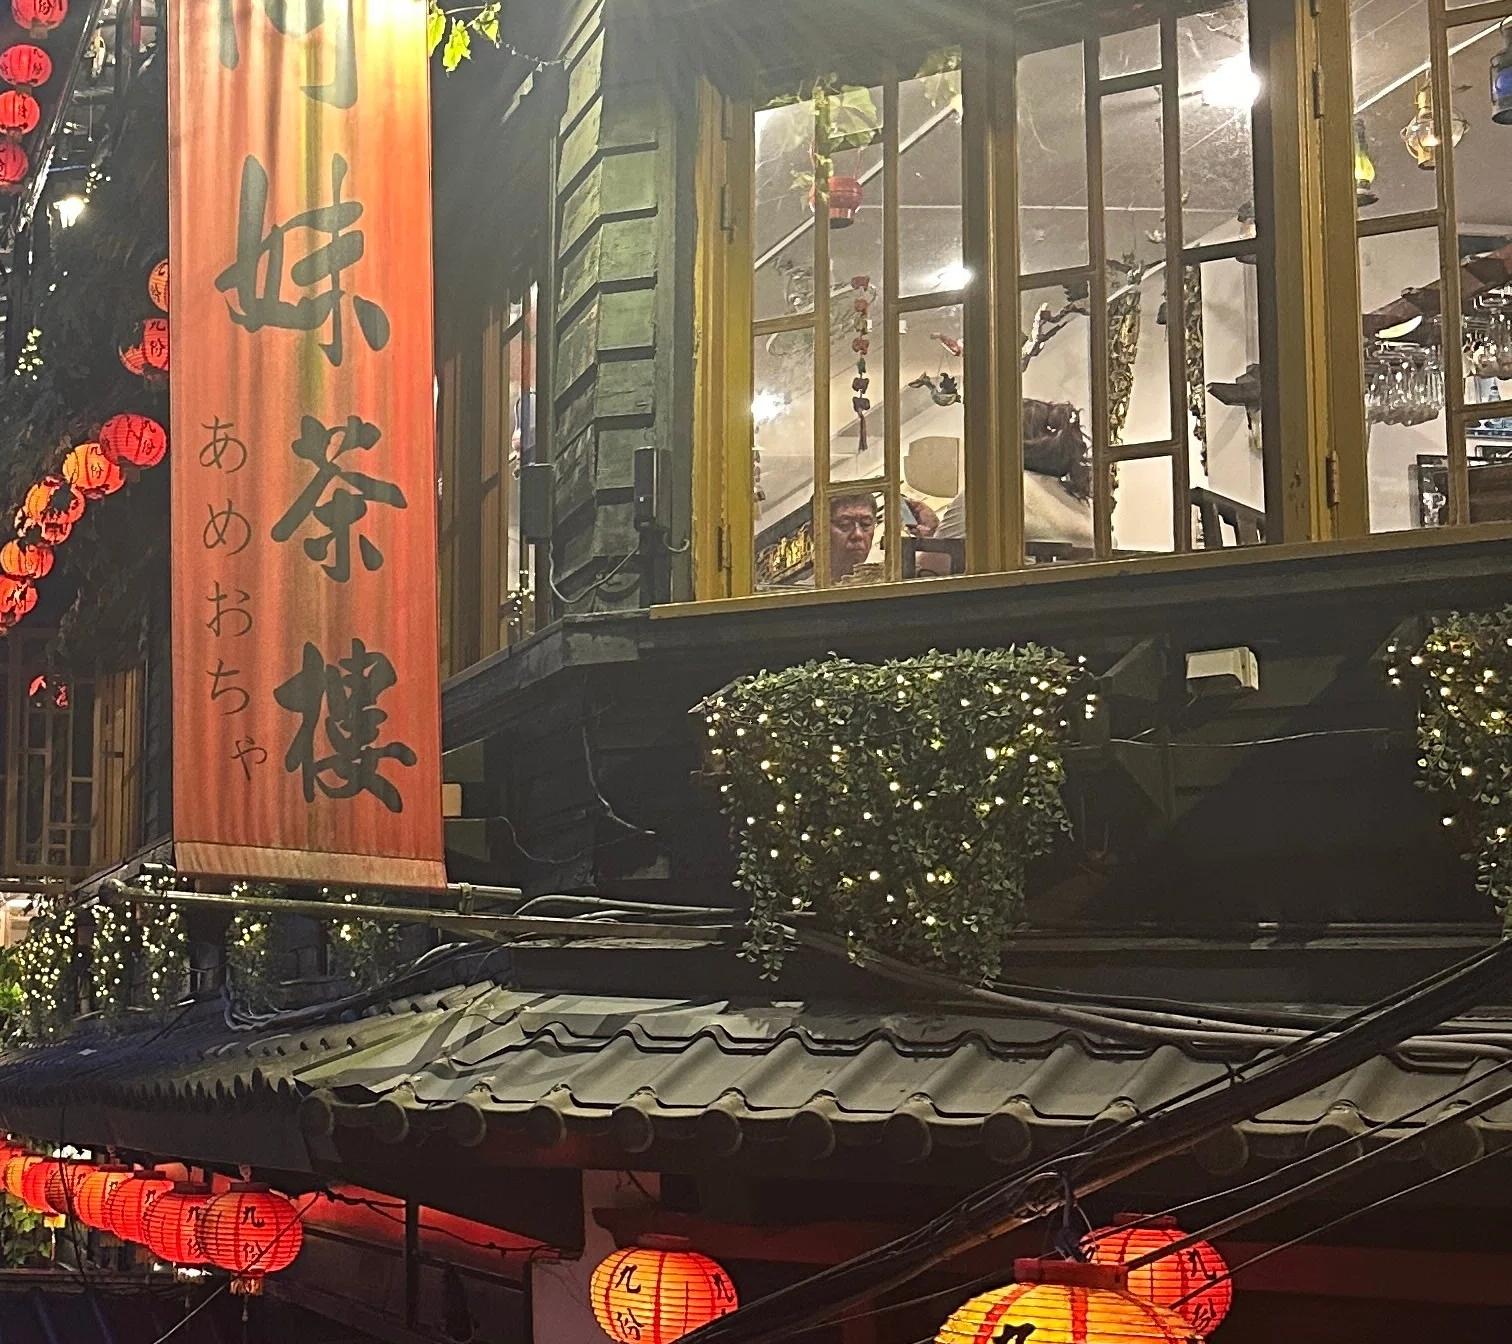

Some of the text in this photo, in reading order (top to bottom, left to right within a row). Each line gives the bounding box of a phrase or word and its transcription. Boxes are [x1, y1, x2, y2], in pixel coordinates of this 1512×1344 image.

[199, 416, 269, 781] あめおちゃ
[615, 1264, 644, 1342] 九份
[1189, 1248, 1218, 1332] 九份
